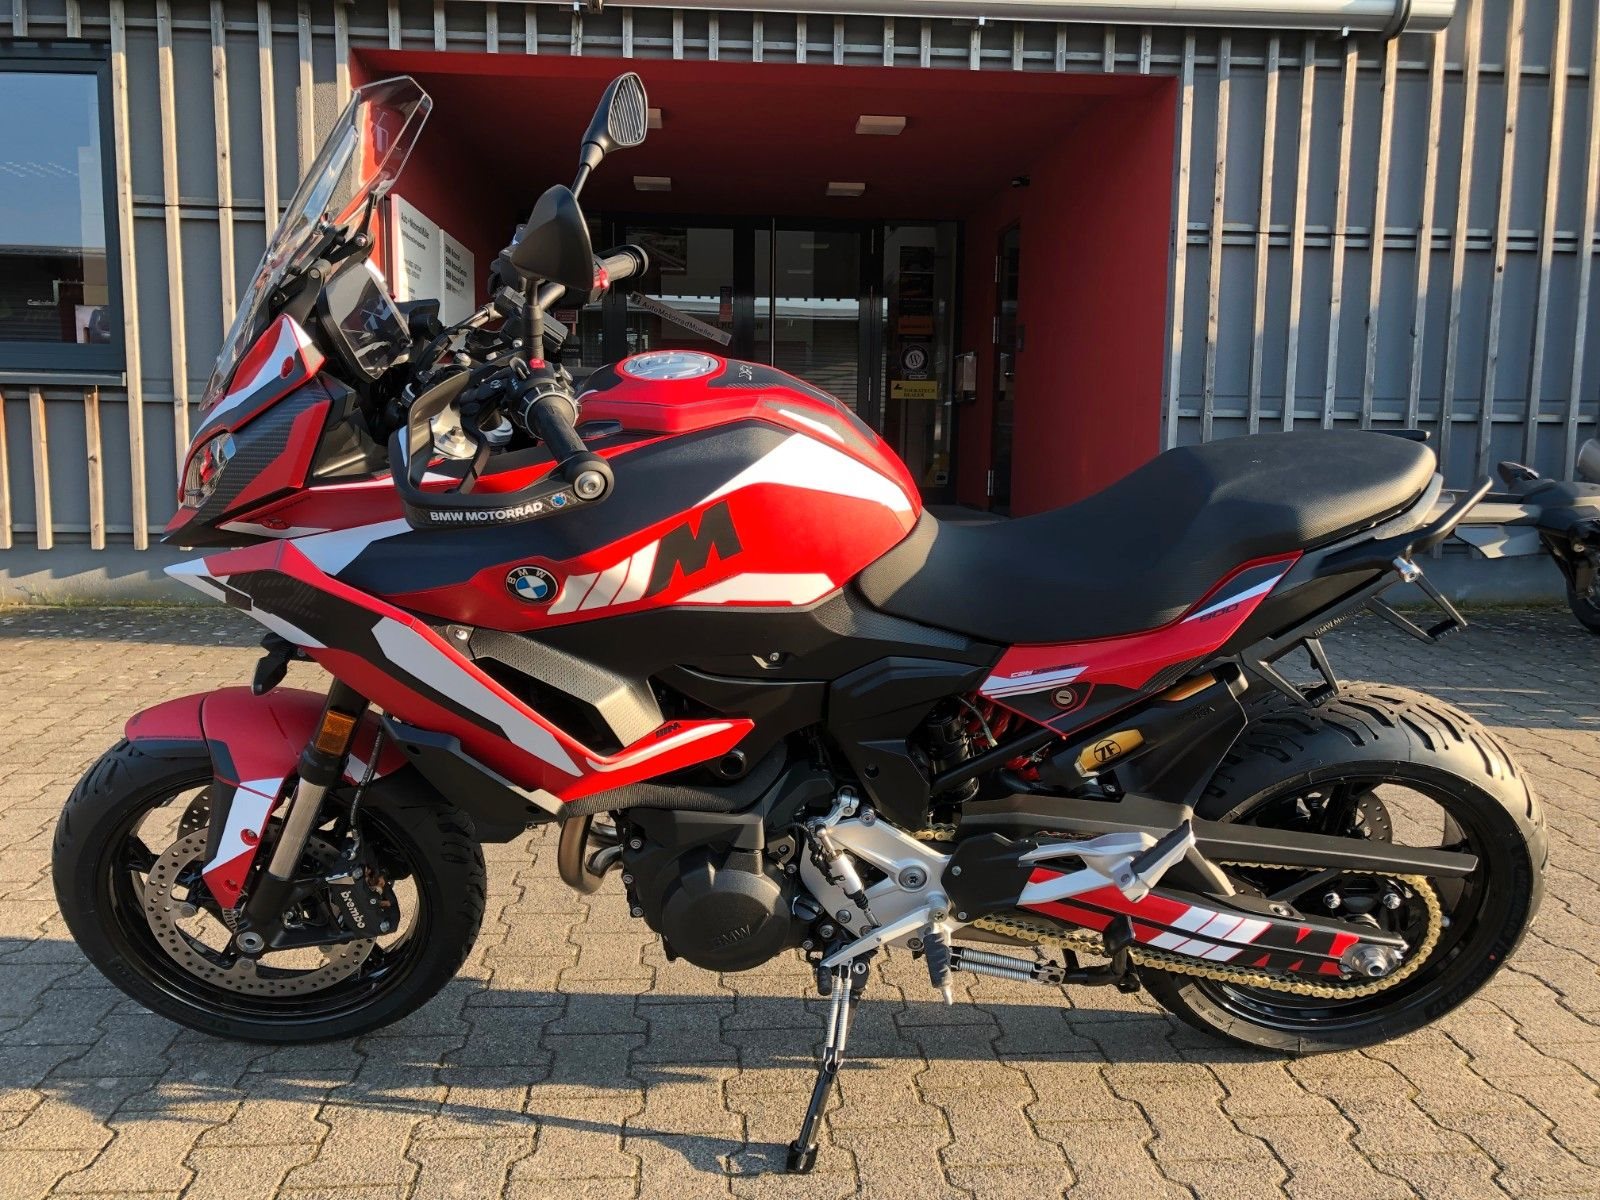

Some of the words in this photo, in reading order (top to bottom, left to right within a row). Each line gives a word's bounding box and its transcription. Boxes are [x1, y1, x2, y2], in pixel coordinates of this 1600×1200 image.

[642, 300, 715, 338] AutoMotorradMueller
[430, 511, 463, 521] BMW
[465, 501, 543, 521] MOTORRAD
[643, 500, 744, 597] M
[507, 567, 546, 585] BMW
[341, 890, 366, 929] brembo
